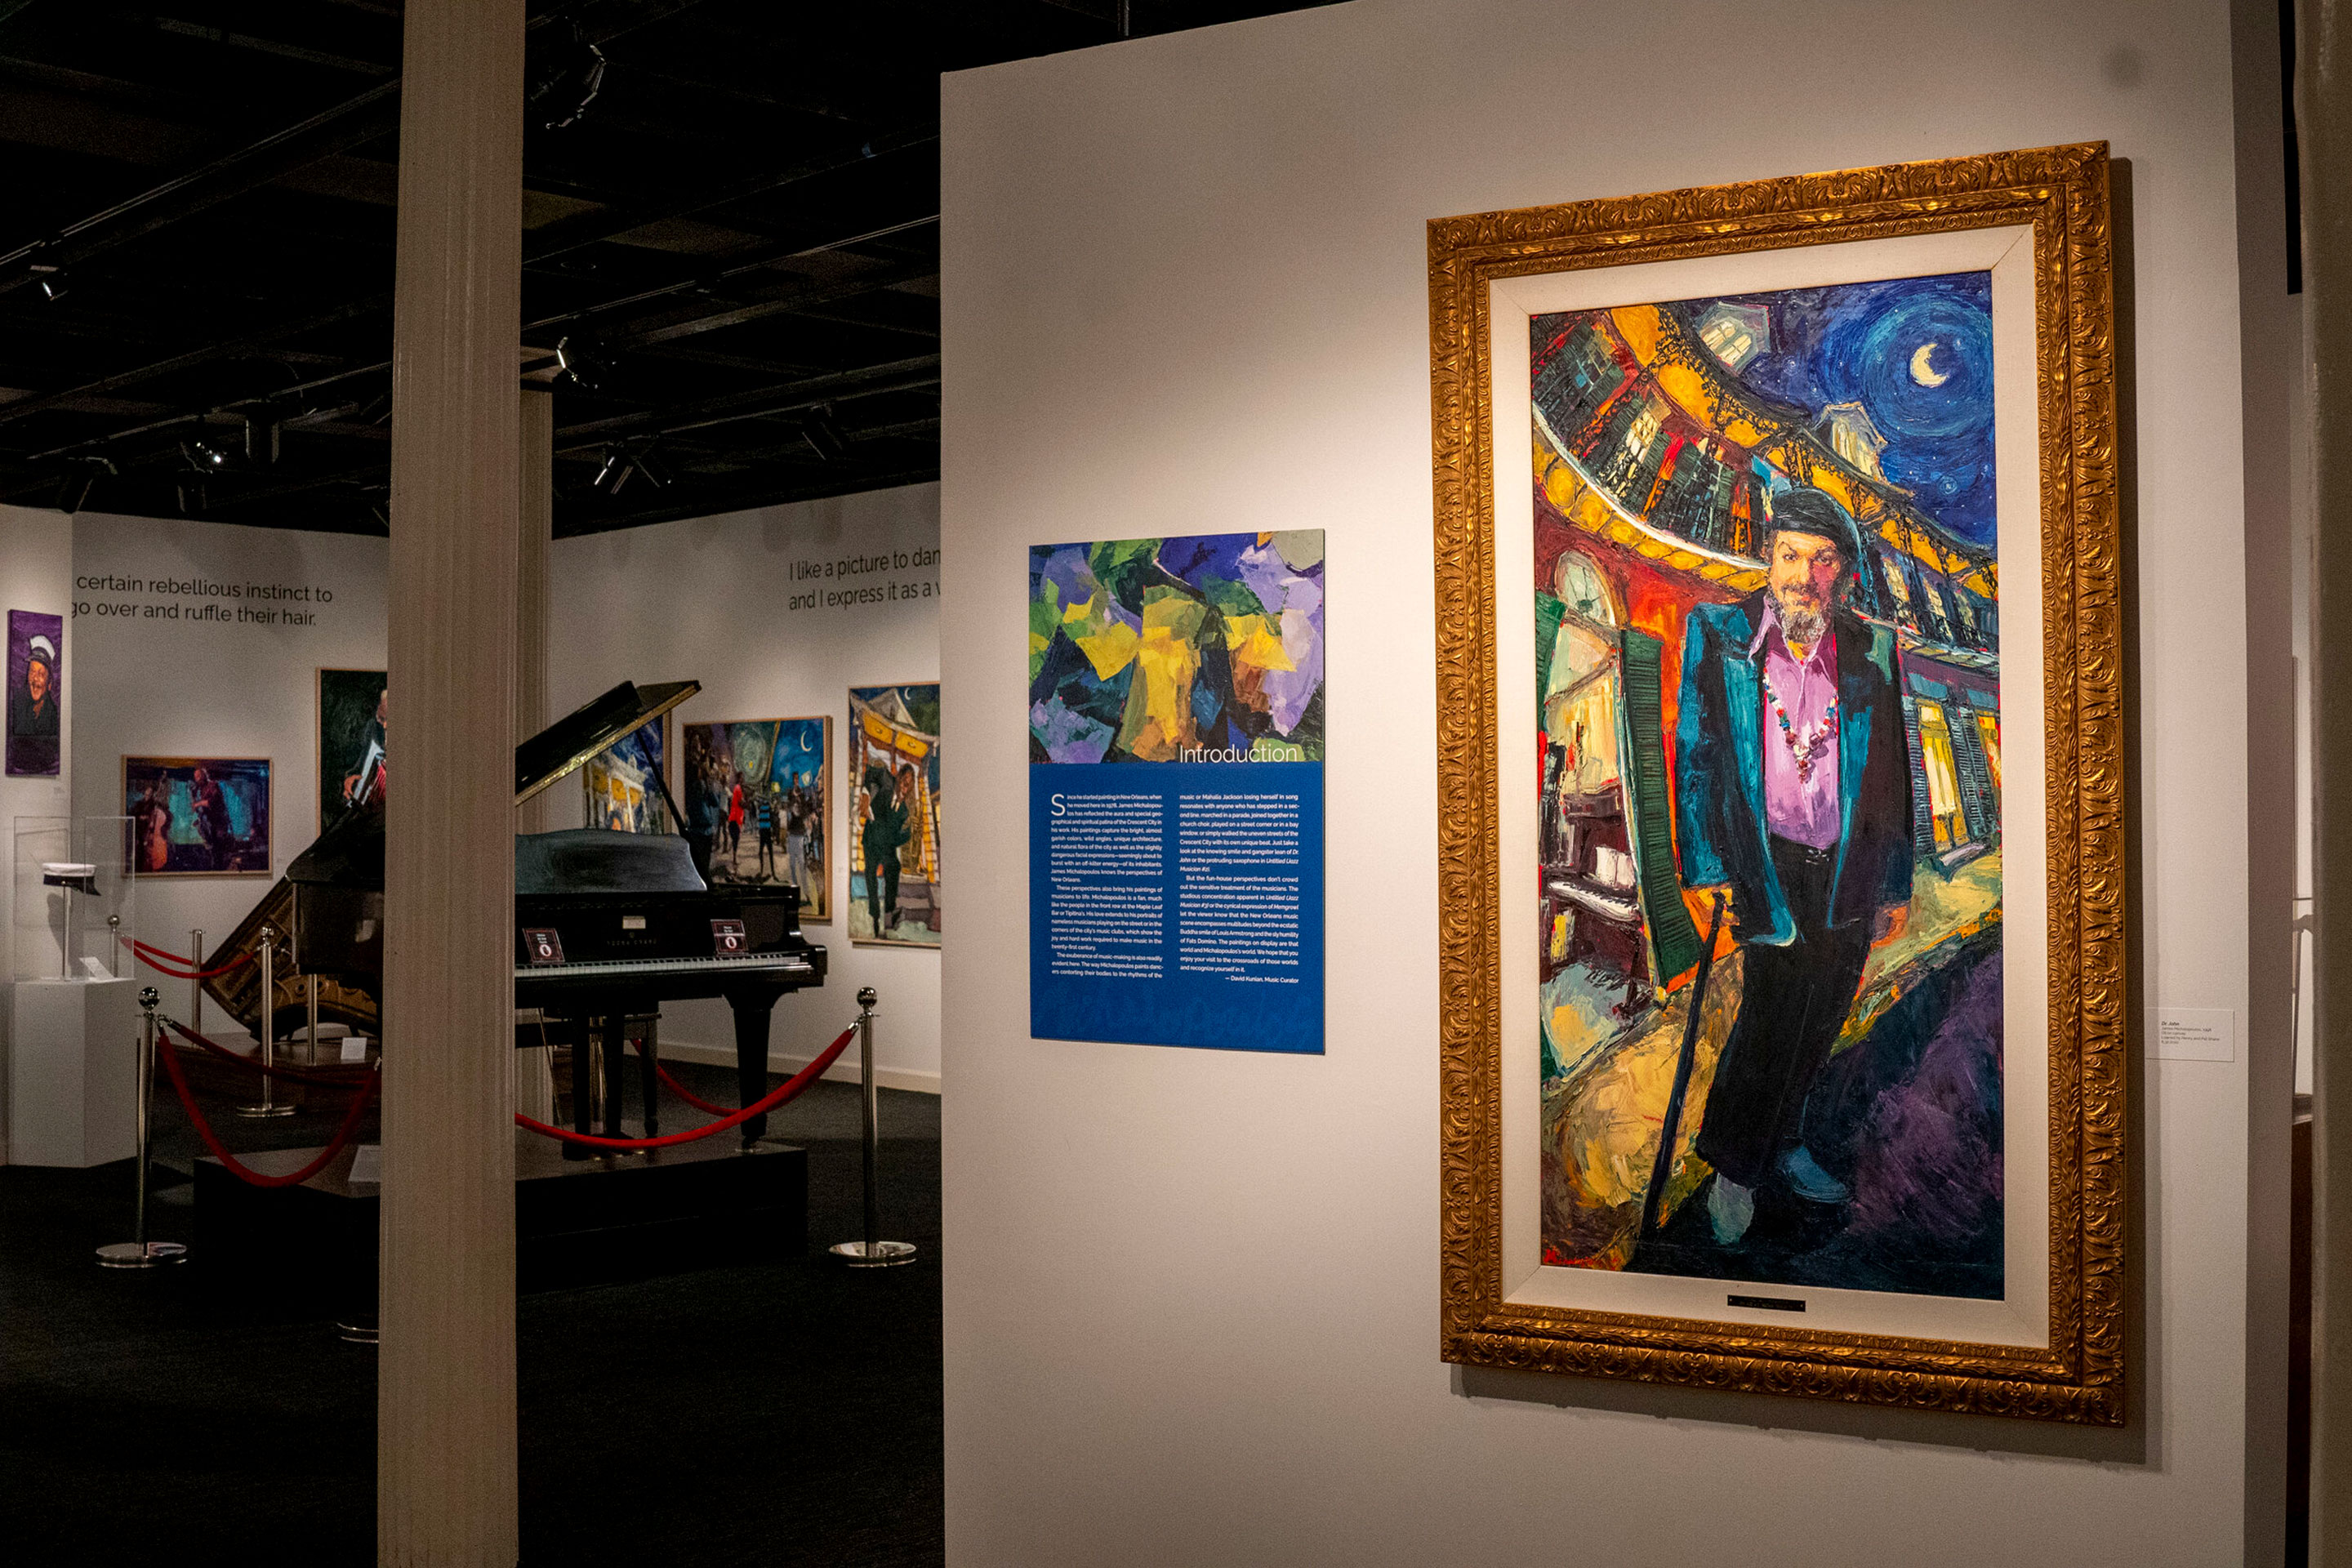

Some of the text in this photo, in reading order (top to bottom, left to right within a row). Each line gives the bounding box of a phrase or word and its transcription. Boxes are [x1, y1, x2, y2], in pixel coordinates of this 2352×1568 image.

[797, 559, 822, 581] like
[825, 562, 833, 577] a
[837, 555, 889, 580] picture
[893, 551, 908, 569] to
[77, 575, 332, 603] certain rebellious instinct to
[789, 590, 815, 610] and
[827, 587, 884, 610] express
[888, 581, 897, 600] it
[901, 583, 918, 599] as
[922, 582, 931, 597] a
[96, 602, 139, 617] over
[144, 603, 178, 619] and
[185, 605, 232, 621] ruffle
[237, 608, 278, 624] their
[283, 609, 316, 626] hair.
[1180, 744, 1297, 763] Introduction
